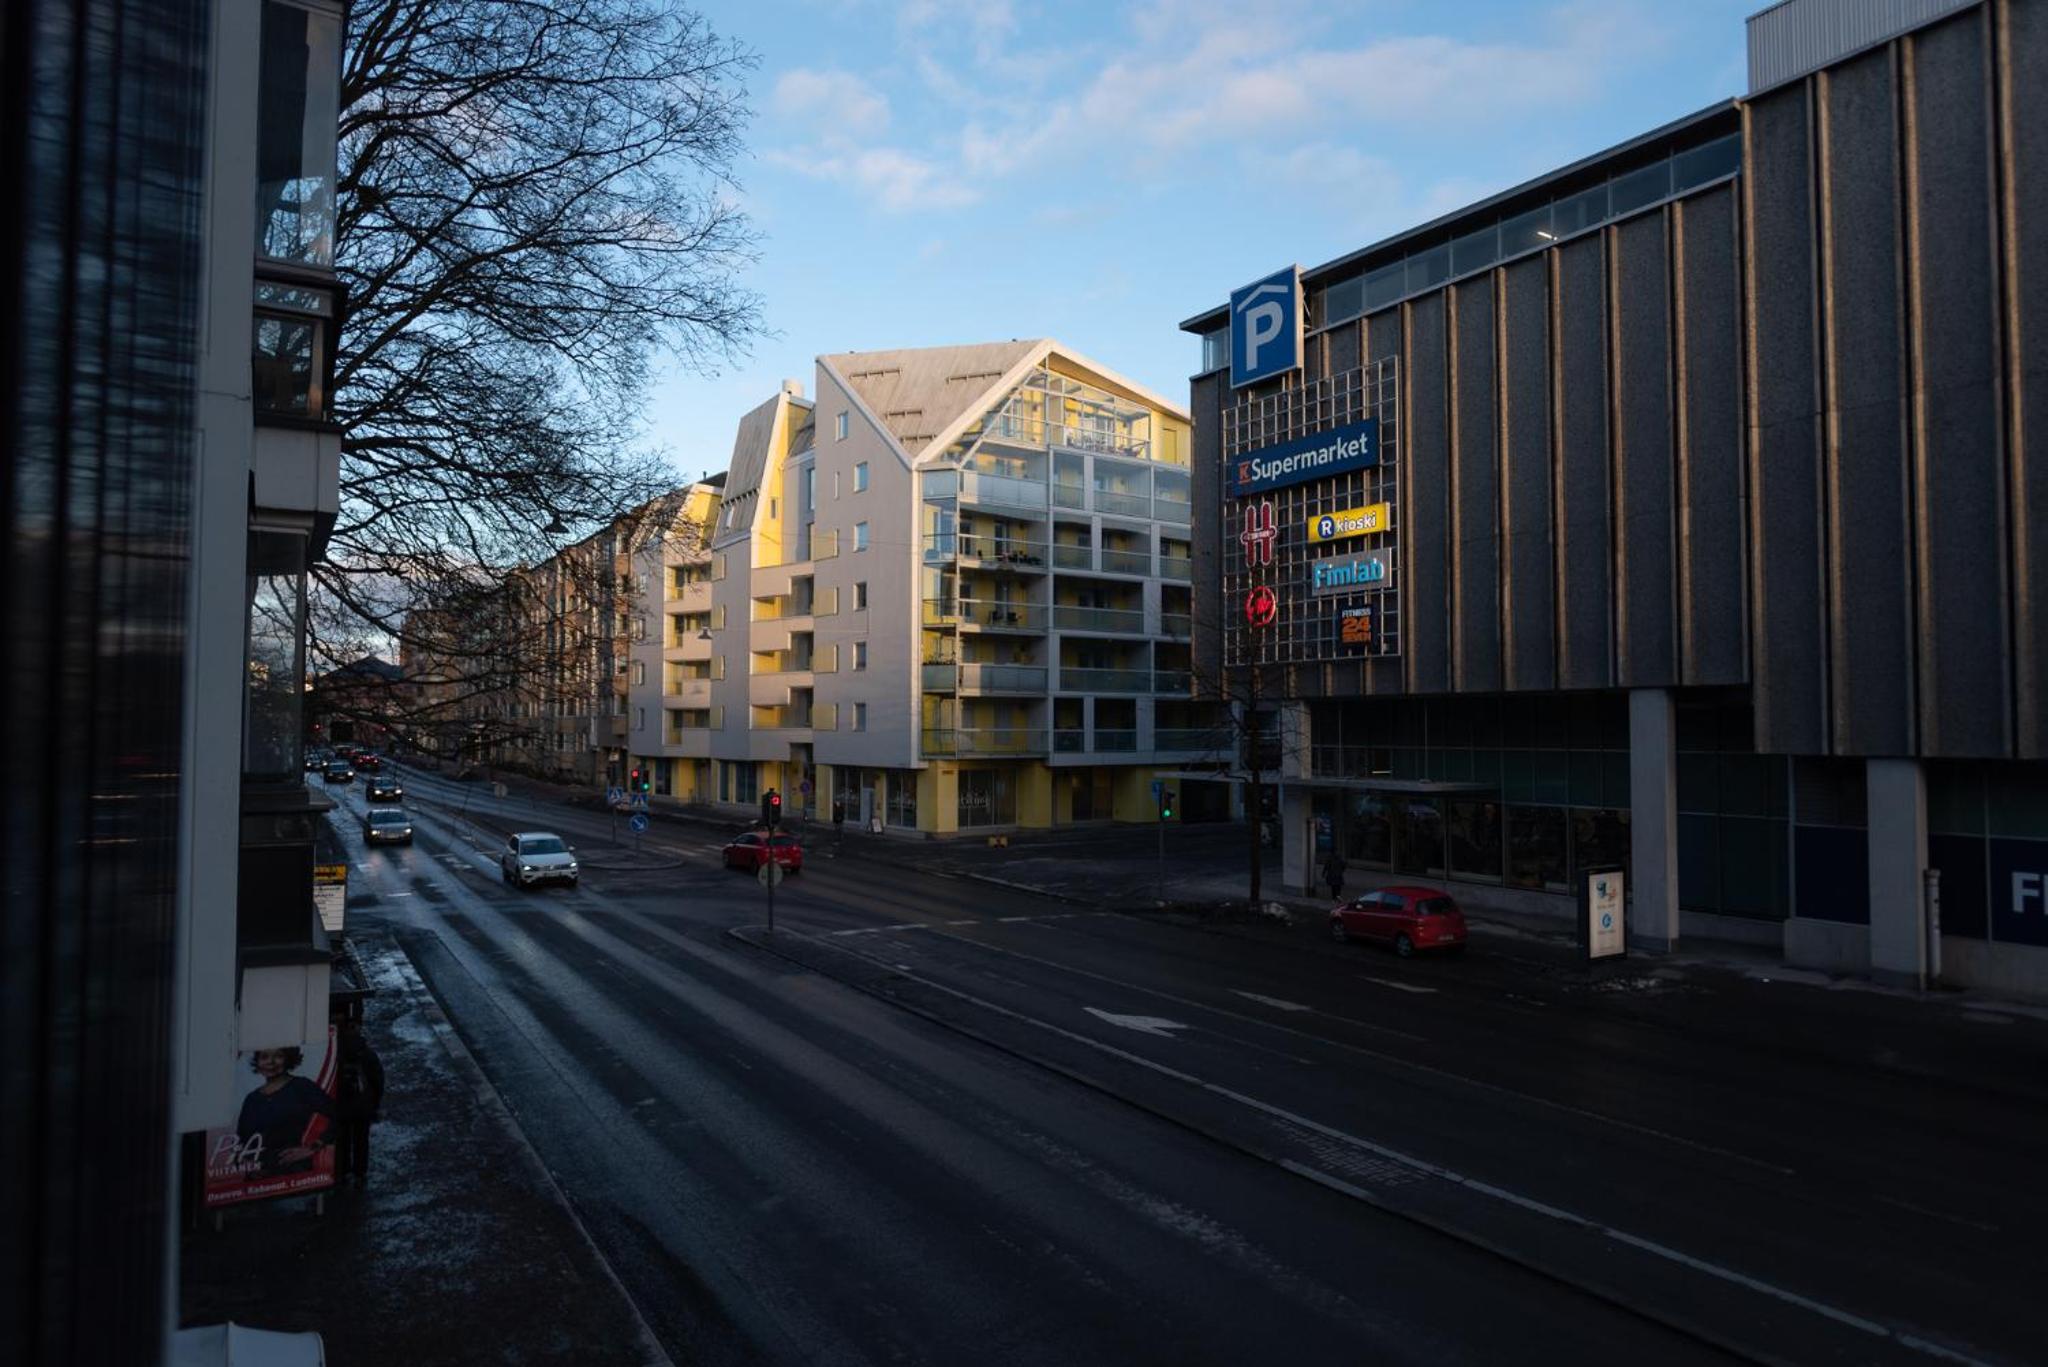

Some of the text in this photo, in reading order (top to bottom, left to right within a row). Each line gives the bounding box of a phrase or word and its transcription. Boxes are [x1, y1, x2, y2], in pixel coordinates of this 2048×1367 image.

[1246, 301, 1284, 371] P
[1251, 432, 1368, 481] Supermarket
[1336, 512, 1377, 532] kioski
[1314, 557, 1385, 589] Fimlab
[1343, 617, 1371, 632] 24
